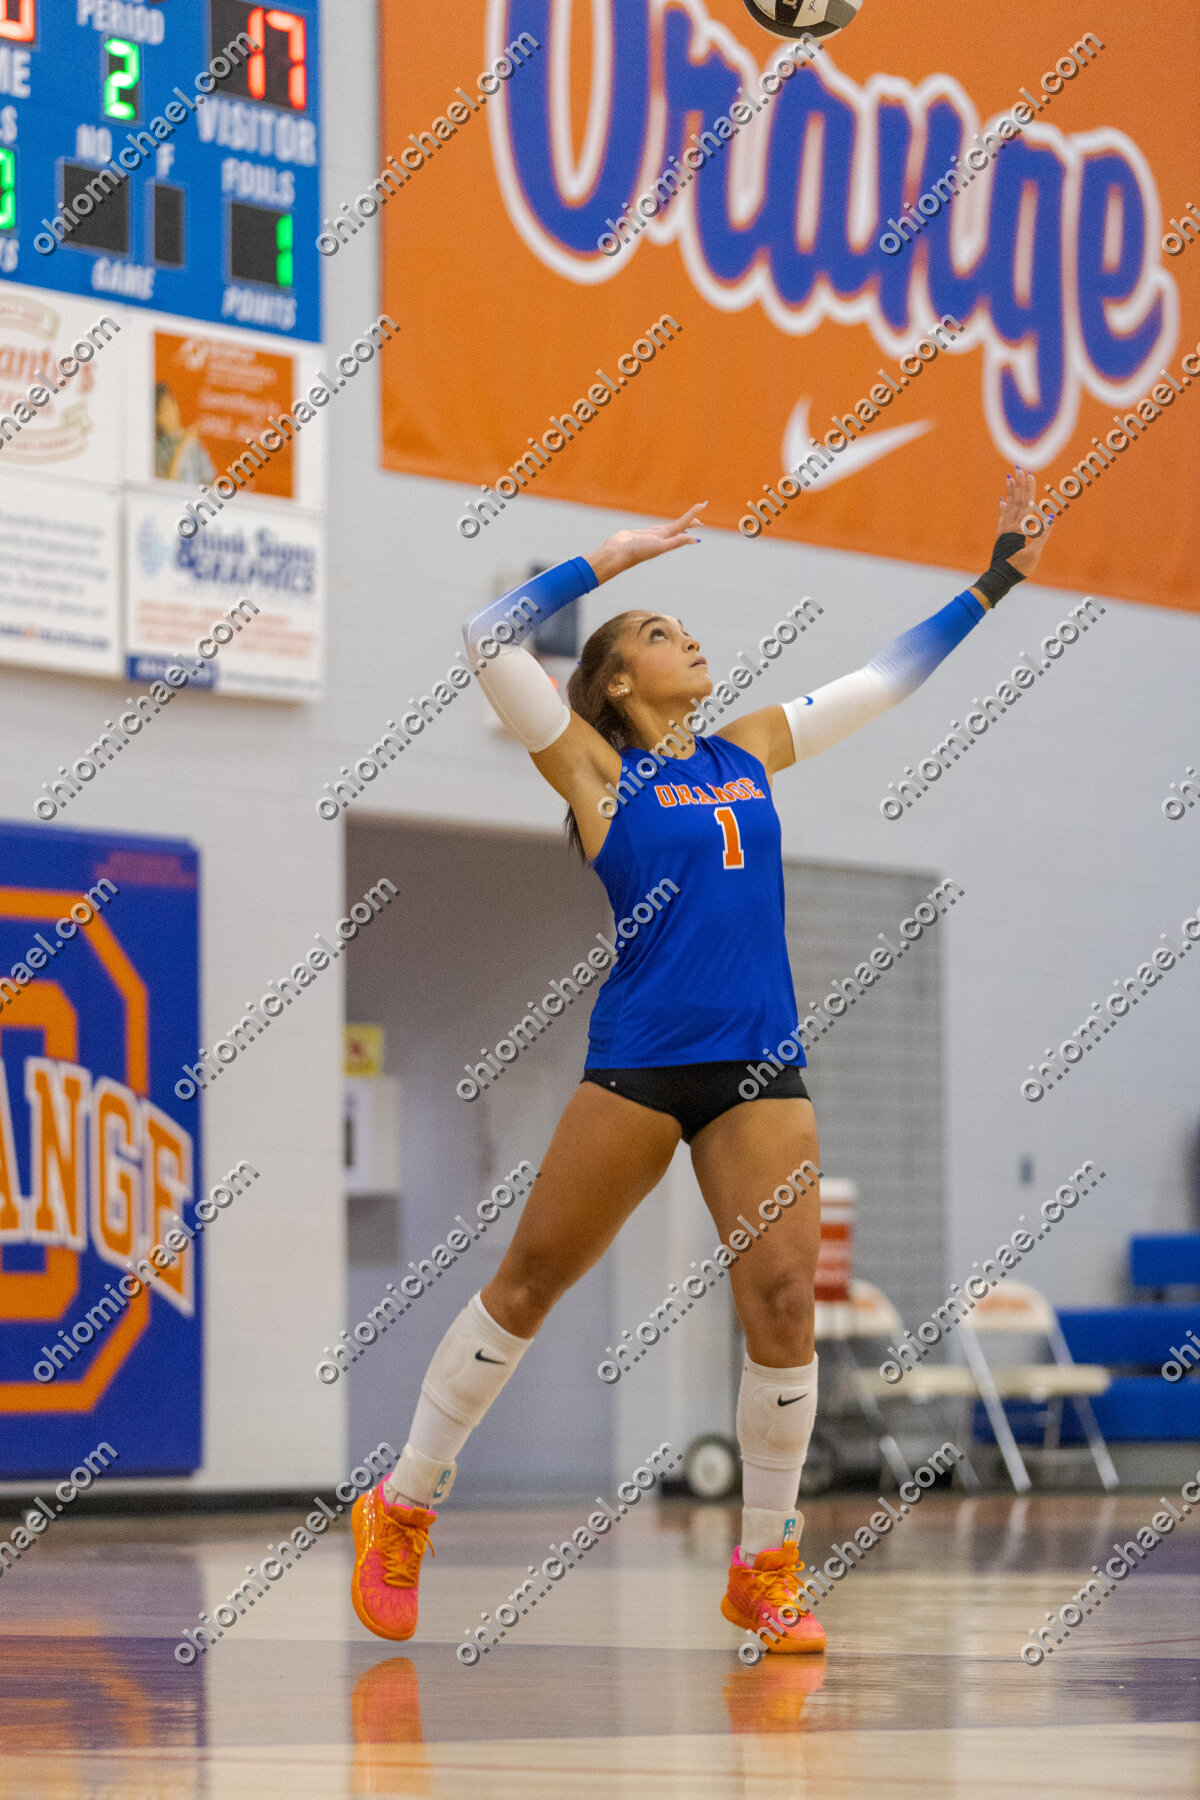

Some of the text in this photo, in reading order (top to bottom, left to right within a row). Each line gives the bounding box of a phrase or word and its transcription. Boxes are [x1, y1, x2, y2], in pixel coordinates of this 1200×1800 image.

[76, 0, 165, 45] PERIOD
[103, 38, 140, 121] 2
[247, 6, 307, 111] 17
[197, 97, 317, 167] VISITOR
[221, 158, 296, 207] FOULS
[276, 213, 294, 287] 1
[484, 0, 1180, 467] Orange
[220, 286, 297, 331] POINTS
[653, 776, 767, 809] ORANGE
[713, 806, 745, 871] 1
